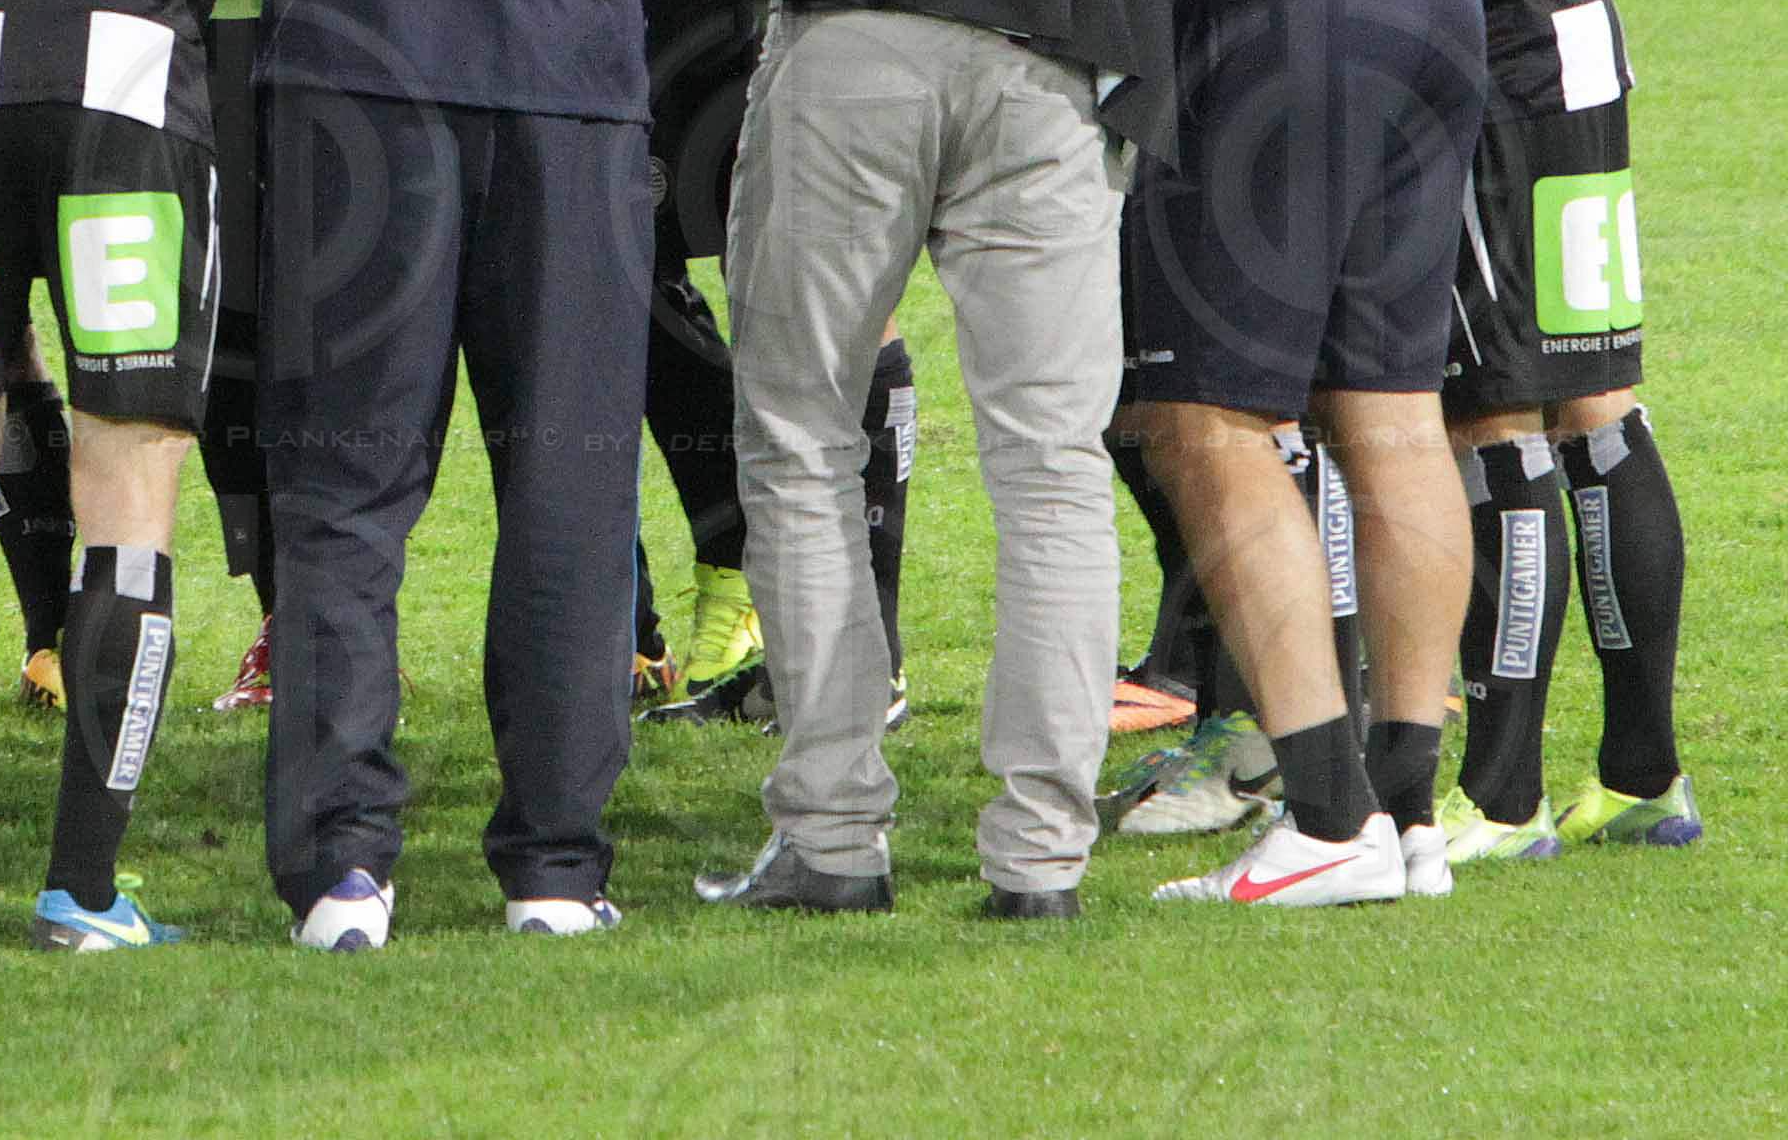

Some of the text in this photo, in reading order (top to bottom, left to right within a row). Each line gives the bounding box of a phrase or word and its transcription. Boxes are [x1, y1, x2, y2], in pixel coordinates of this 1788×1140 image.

[1500, 520, 1538, 668] PUNTIGAMER
[1588, 498, 1620, 639] PUNTIGAMER
[113, 626, 167, 784] PUNTIGAMER
